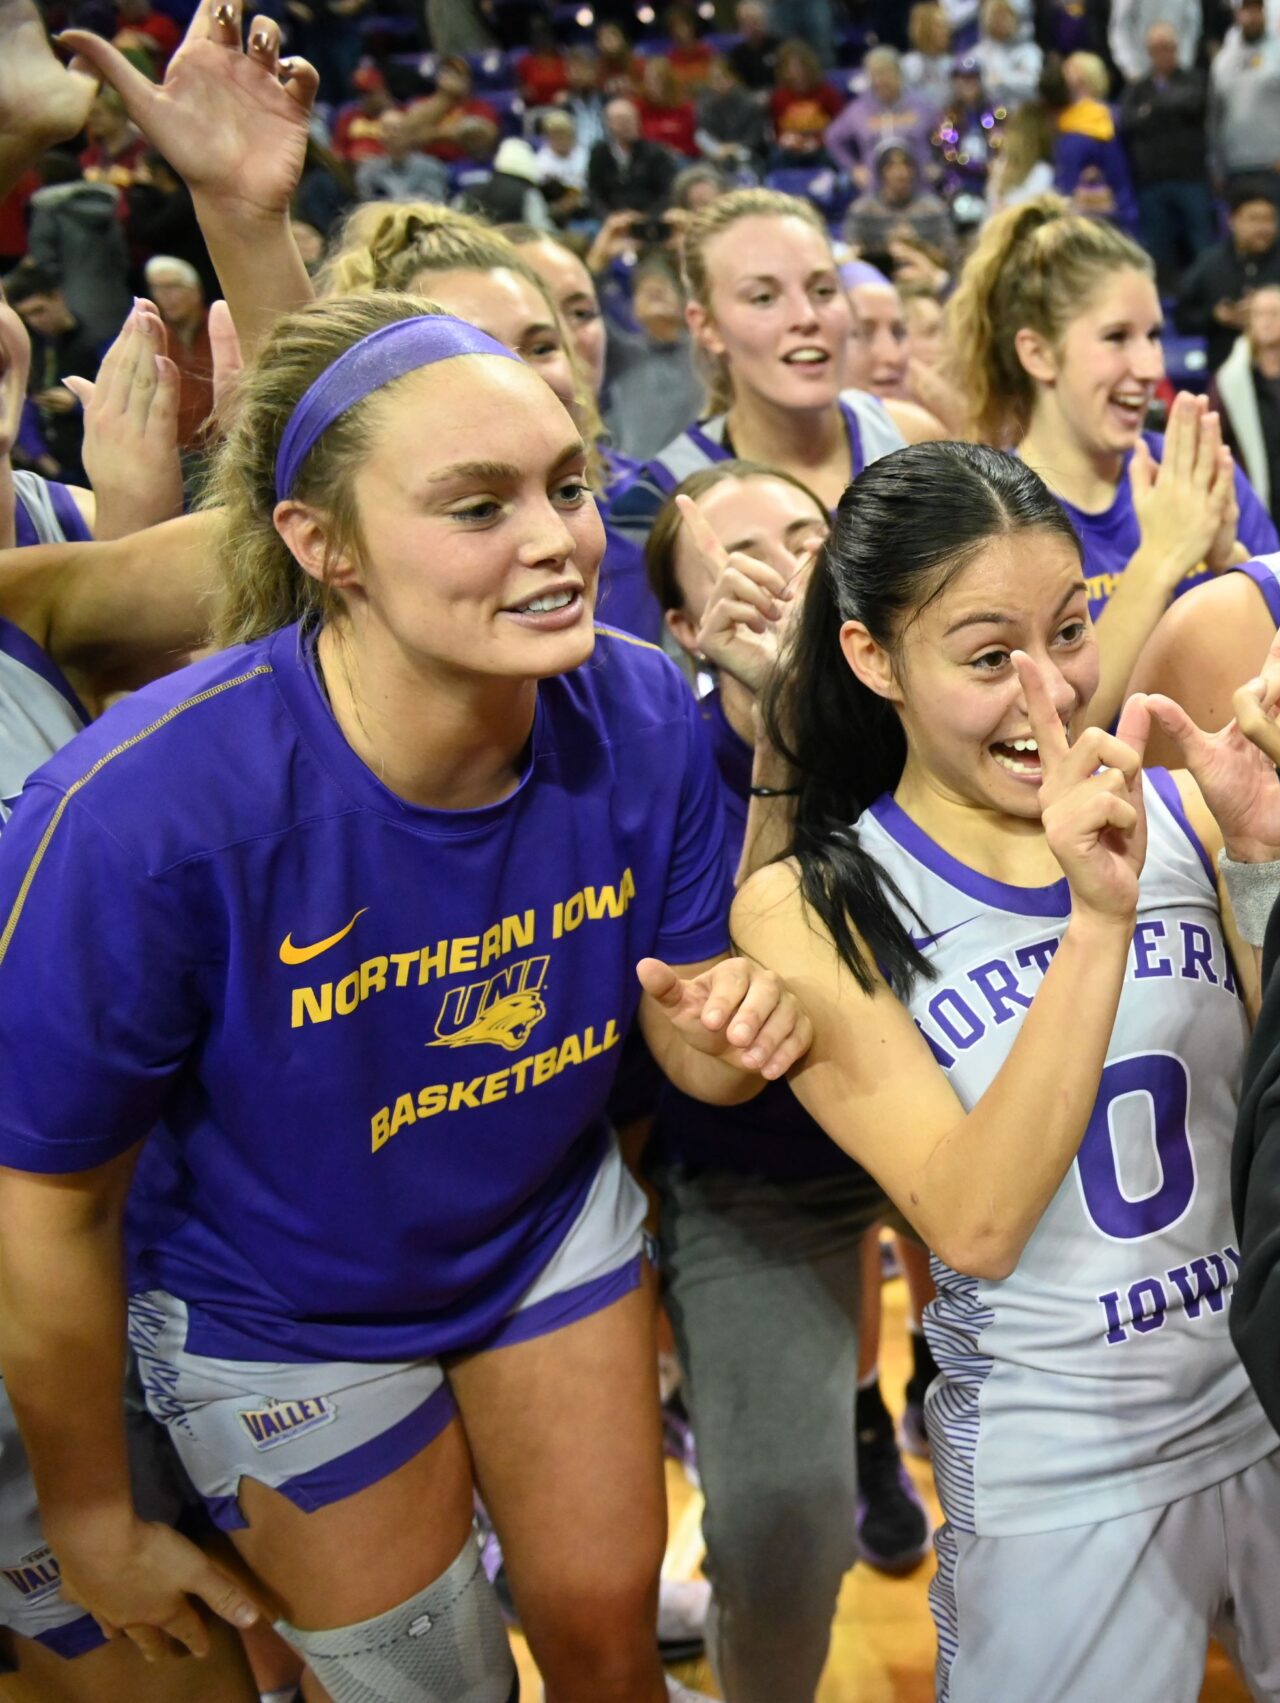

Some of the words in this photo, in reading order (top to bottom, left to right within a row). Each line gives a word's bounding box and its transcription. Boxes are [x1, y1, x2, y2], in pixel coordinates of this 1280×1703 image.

[291, 909, 535, 1028] NORTHERN
[552, 867, 636, 940] IOWA
[434, 955, 550, 1039] UNI
[914, 920, 1236, 1069] ORTER
[371, 1019, 620, 1154] BASKETBALL
[1075, 1052, 1196, 1242] 0
[1098, 1247, 1241, 1345] IOW
